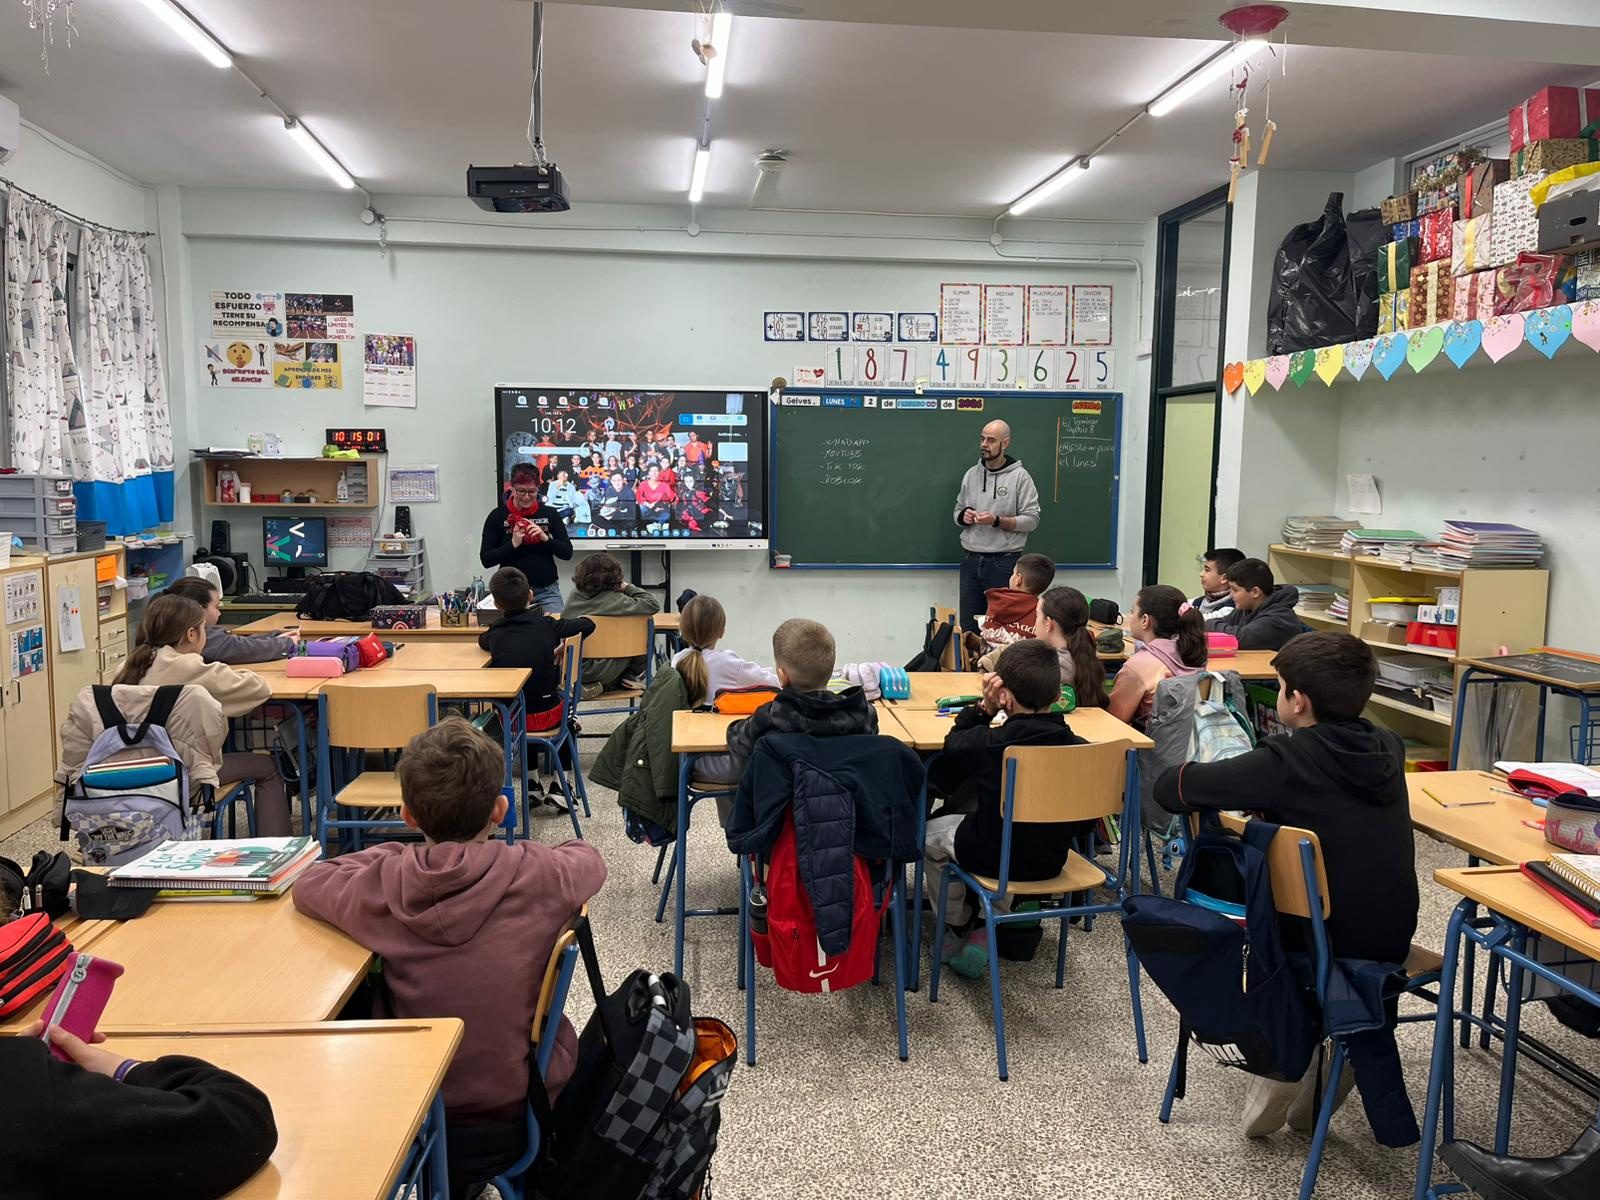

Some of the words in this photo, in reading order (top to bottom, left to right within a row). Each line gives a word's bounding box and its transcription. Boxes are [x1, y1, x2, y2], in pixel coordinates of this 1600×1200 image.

[224, 292, 251, 300] TODO
[215, 302, 262, 310] ESFUERZO
[835, 347, 842, 380] 1
[865, 347, 877, 381] 8
[893, 348, 907, 381] 7
[936, 348, 949, 381] 4
[967, 348, 979, 380] 9
[997, 349, 1008, 382] 3
[1033, 350, 1047, 382] 6
[1066, 351, 1079, 383] 2
[1096, 351, 1108, 382] 5
[531, 418, 577, 434] 10:12
[1448, 590, 1458, 601] 22
